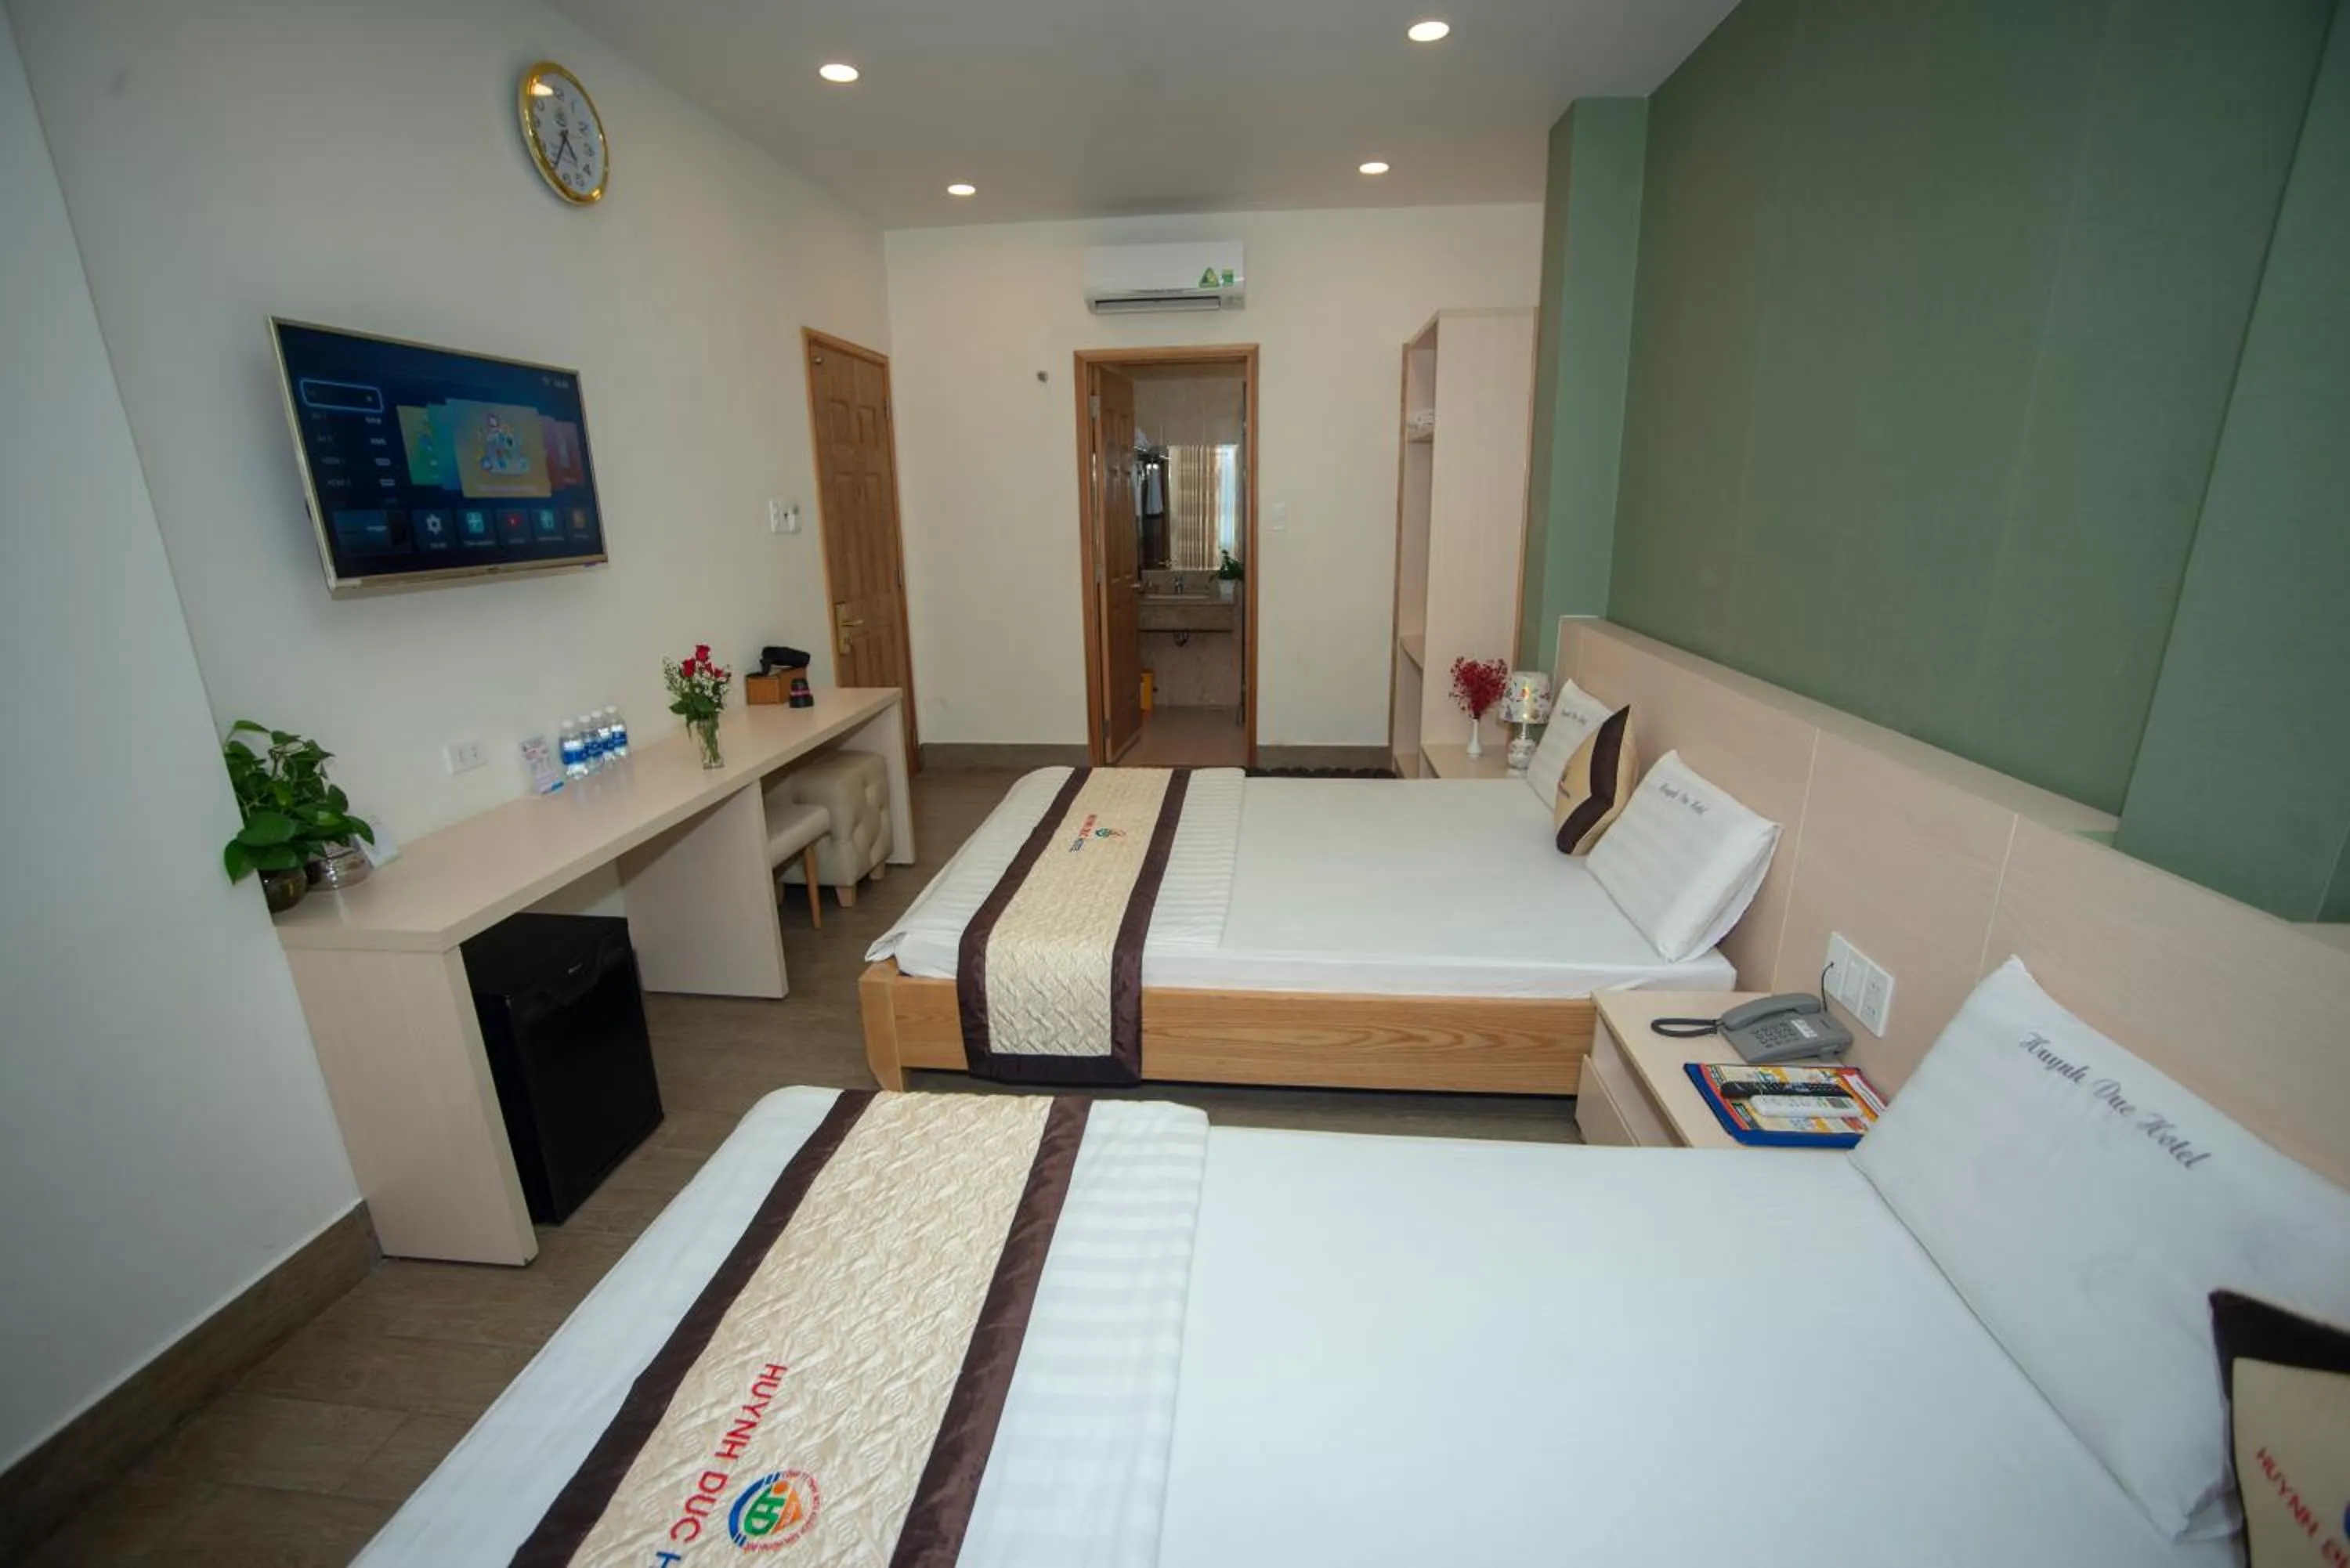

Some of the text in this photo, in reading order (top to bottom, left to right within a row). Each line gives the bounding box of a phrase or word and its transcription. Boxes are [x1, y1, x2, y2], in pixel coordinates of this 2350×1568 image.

[2019, 1031, 2211, 1170] Huynh Duc Hotel
[714, 1363, 787, 1460] HUYNH
[670, 1470, 728, 1544] DUC
[2256, 1447, 2319, 1537] HUYNH
